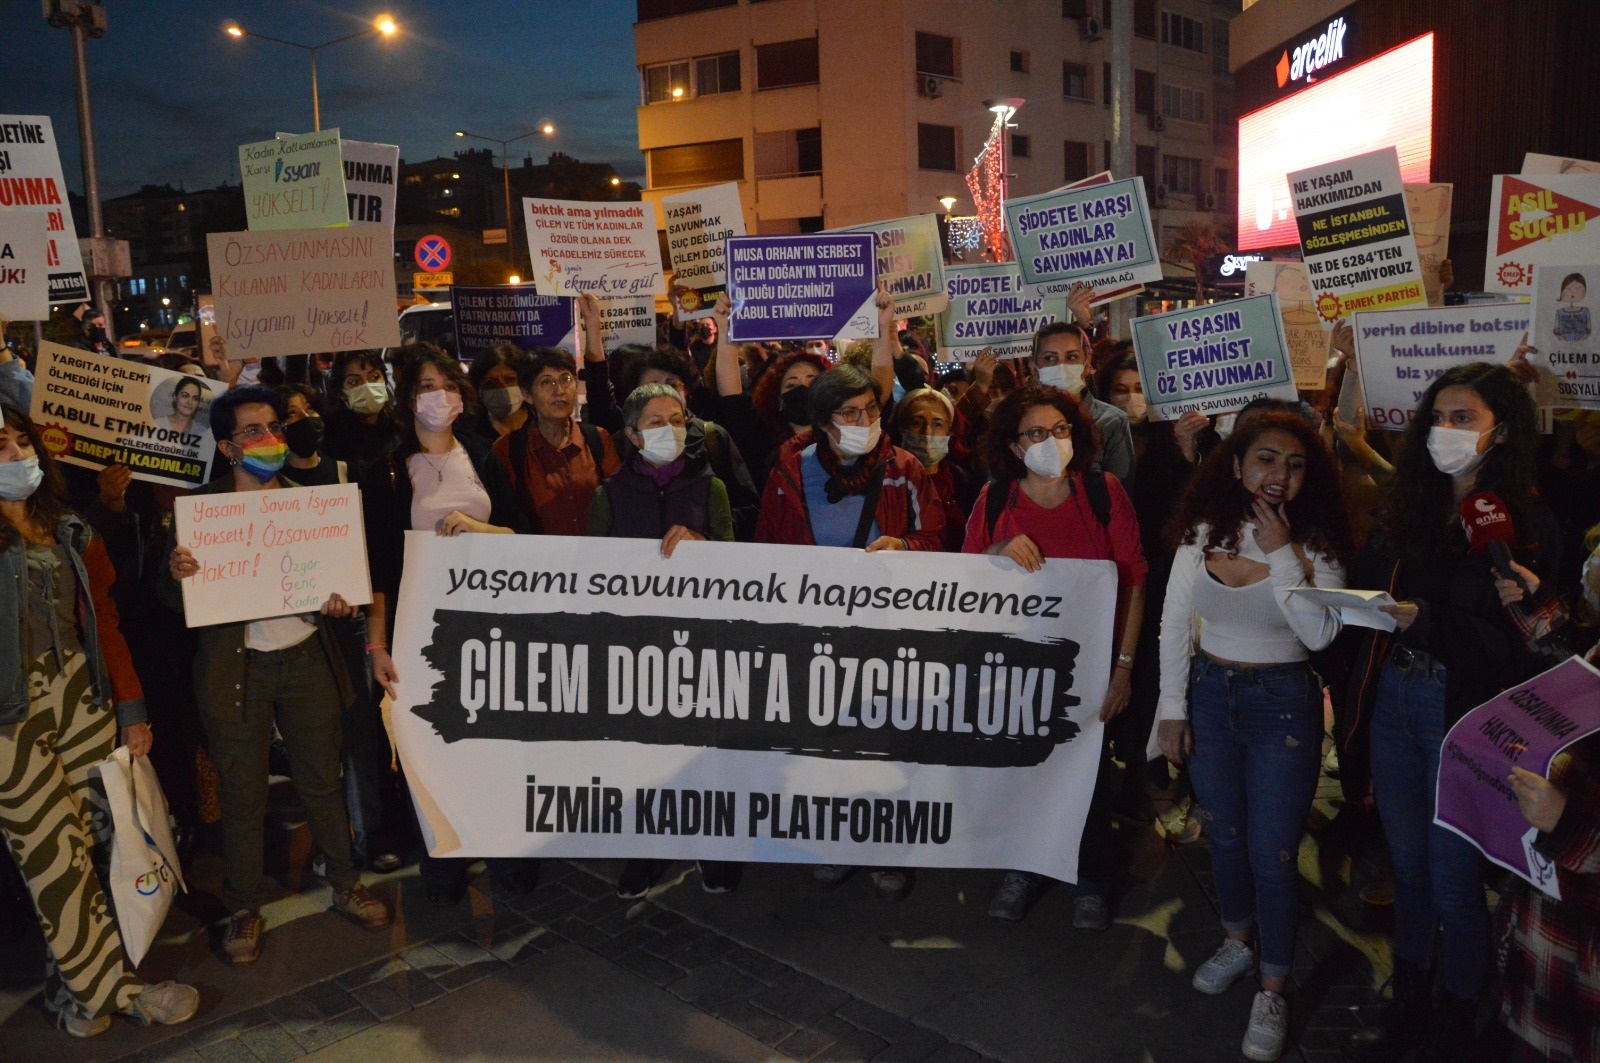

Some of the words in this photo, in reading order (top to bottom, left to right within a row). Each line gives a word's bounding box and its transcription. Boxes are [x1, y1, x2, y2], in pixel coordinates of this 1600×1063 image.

[1290, 16, 1346, 82] arçelik
[244, 146, 275, 161] Kadın
[275, 158, 320, 183] İsyanı
[1294, 180, 1309, 194] NE
[1310, 170, 1353, 190] YAŞAM
[1297, 180, 1382, 210] HAKKIMIZDAN
[1507, 190, 1558, 215] ASIL
[532, 203, 564, 216] bıktık
[567, 208, 591, 217] ama
[594, 207, 644, 220] yılmadık
[667, 204, 702, 219] YAŞAMI
[1019, 205, 1078, 235] ŞİDDETE
[1083, 194, 1132, 220] KARŞI
[1313, 219, 1327, 230] NE
[1331, 206, 1390, 226] İSTANBUL
[536, 218, 562, 229] ÇİLEM
[576, 220, 594, 230] TÜM
[596, 222, 643, 230] KADINLAR
[669, 216, 721, 234] SAVUNMAK
[1306, 220, 1406, 249] SÖZLEŞMESİNDEN
[1509, 212, 1586, 243] SUÇLU
[550, 233, 578, 244] ÖZGÜR
[581, 236, 611, 244] OLANA
[613, 236, 631, 244] DEK
[672, 238, 688, 249] SUÇ
[690, 230, 733, 246] DEĞİLDİR
[1040, 223, 1116, 250] KADINLAR
[225, 236, 374, 267] ÖZSAVUNMASINI
[541, 248, 602, 259] MÜCADELEMİZ
[604, 249, 646, 258] SÜRECEK
[674, 252, 700, 265] ÇİLEM
[734, 248, 764, 261] MUSA
[766, 246, 814, 260] ORHAN'IN
[817, 244, 862, 258] SERBEST
[1034, 242, 1134, 274] SAVUNMAYA!
[1309, 262, 1323, 275] NE
[1326, 259, 1339, 271] DE
[1342, 246, 1402, 268] 6284'TEN
[564, 265, 582, 274] izmir
[735, 266, 766, 283] ÇİLEM
[768, 264, 816, 279] DOĞAN'IN
[818, 264, 864, 278] TUTUKLU
[1313, 261, 1413, 291] VAZGEÇMİYORUZ
[219, 275, 287, 297] KULANAN
[301, 270, 384, 292] KADINLARIN
[564, 274, 611, 293] ekmek
[611, 278, 628, 288] ve
[629, 273, 658, 293] gül
[735, 284, 775, 300] OLDUĞU
[777, 282, 834, 299] DÜZENİNİZİ
[948, 275, 1010, 299] ŞİDDETE
[1047, 284, 1070, 294] KADIN
[1119, 272, 1134, 282] AĞI
[458, 296, 494, 309] ÇİLEM'E
[967, 297, 1042, 316] KADINLAR
[1321, 301, 1335, 311] EMEP
[1345, 296, 1375, 310] EMEK
[1378, 287, 1420, 304] PARTİSİ
[460, 310, 525, 322] PATRİYARKAYI
[527, 311, 540, 321] DA
[607, 307, 646, 316] 6284'TEN
[736, 305, 770, 319] KABUL
[772, 303, 833, 318] ETMİYORUZ!
[461, 324, 491, 335] ERKEK
[492, 324, 529, 336] ADALETİ
[532, 324, 544, 335] DE
[1168, 311, 1241, 341] YAŞASIN
[1362, 323, 1406, 339] yerin
[1410, 321, 1465, 336] dibine
[331, 327, 368, 348] ÖGK
[1167, 337, 1250, 369] FEMİNİST
[1391, 344, 1496, 357] hukukunuz
[1549, 351, 1587, 367] ÇİLEM
[49, 366, 100, 387] ÖLMEDİĞİ
[101, 379, 124, 393] İÇİN
[52, 353, 109, 375] YARGITAY
[112, 367, 151, 384] ÇİLEM'İ
[1158, 372, 1177, 394] ÖZ
[1183, 361, 1273, 391] SAVUNMA!
[1397, 366, 1420, 379] biz
[47, 383, 142, 413] CEZALANDIRIYOR
[1172, 403, 1200, 414] KADIN
[1202, 395, 1249, 410] SAVUNMA
[42, 401, 100, 427] KABUL
[104, 418, 201, 448] ETMİYORUZ
[44, 433, 66, 445] EMEP
[116, 437, 199, 458] #ÇİLEMEÖZGÜRLÜK
[74, 440, 128, 463] EMEP'Lİ
[130, 453, 201, 476] KADINLAR
[194, 501, 245, 523] Yaşamı
[260, 496, 301, 514] Savun,
[307, 489, 348, 515] İsyanı
[1476, 512, 1505, 524] anka
[263, 520, 348, 548] Özsavunma
[191, 553, 260, 586] Haktır!
[281, 575, 316, 591] Genç
[446, 568, 578, 599] yaşamı
[586, 572, 787, 603] savunmak
[798, 574, 1062, 618] hapsedilemez
[283, 594, 319, 610] Kadın
[460, 627, 589, 724] ÇİLEM
[607, 630, 790, 723] DOĞAN'A
[808, 643, 1056, 737] ÖZGÜRLÜK!
[1508, 687, 1579, 740] ÖZSAVUNMA
[525, 775, 623, 834] İZMİR
[636, 788, 736, 837] KADIN
[749, 792, 953, 844] PLATFORMU
